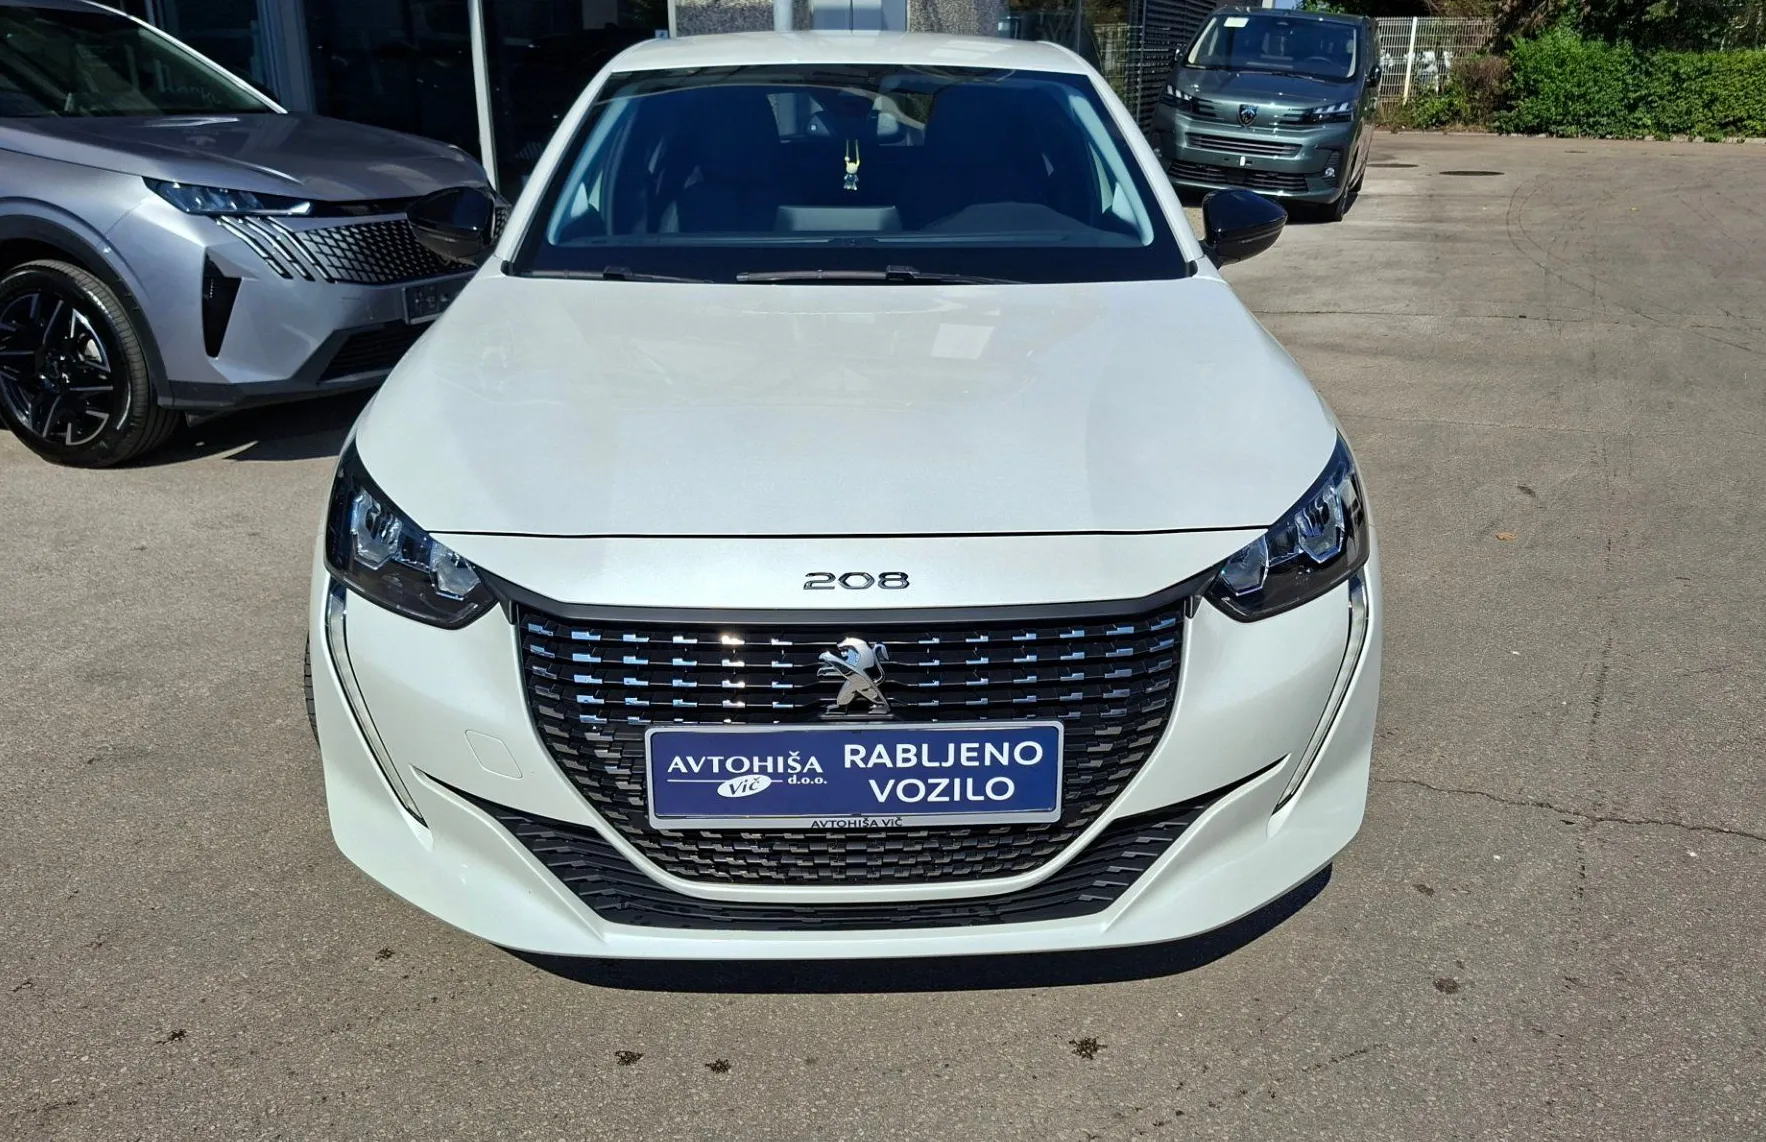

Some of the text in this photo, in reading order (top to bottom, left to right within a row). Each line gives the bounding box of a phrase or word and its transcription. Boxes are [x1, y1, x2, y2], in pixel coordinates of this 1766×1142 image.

[803, 572, 910, 590] 208
[667, 751, 823, 774] AVTOHIŠA
[844, 740, 1044, 769] RABLJENO
[727, 775, 828, 796] Vič d.o.o.
[868, 776, 1015, 803] VOZILO
[811, 817, 879, 828] AVTOHIŠA
